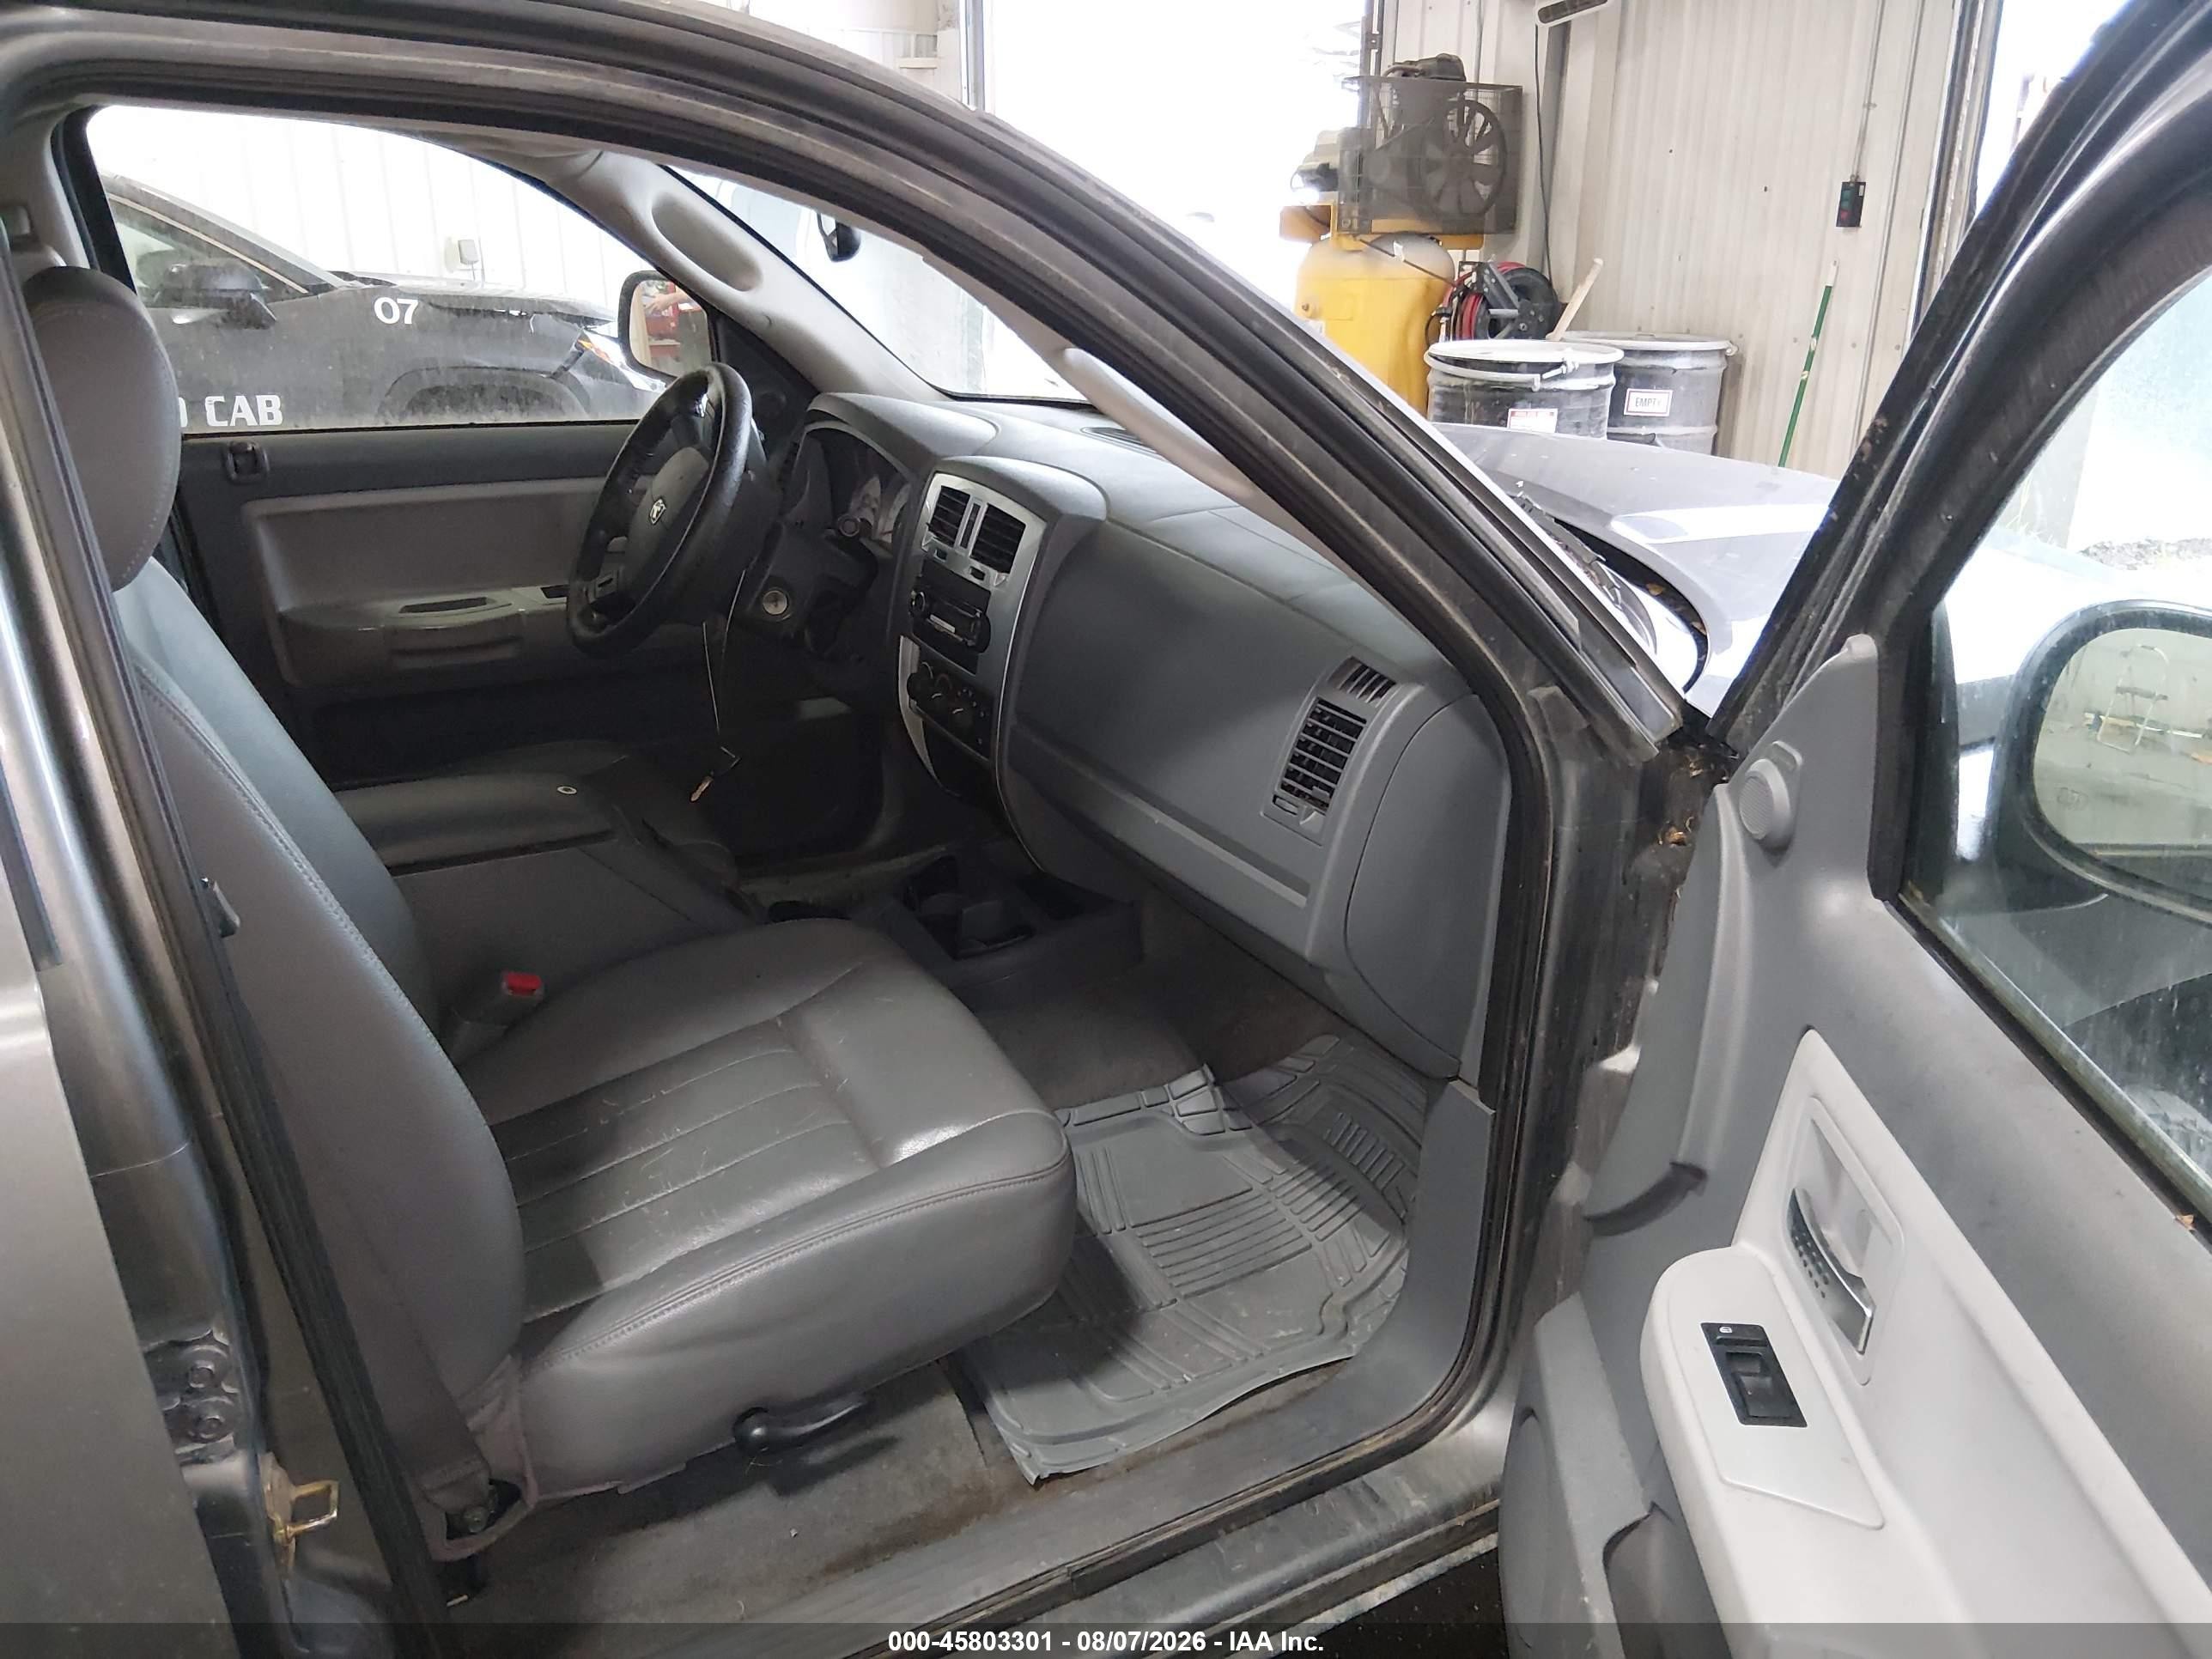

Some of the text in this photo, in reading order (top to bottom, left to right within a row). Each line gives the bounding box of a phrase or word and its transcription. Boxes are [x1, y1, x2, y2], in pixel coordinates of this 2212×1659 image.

[374, 296, 419, 325] 07
[205, 394, 283, 427] CAB
[1635, 397, 1662, 408] EMPTY
